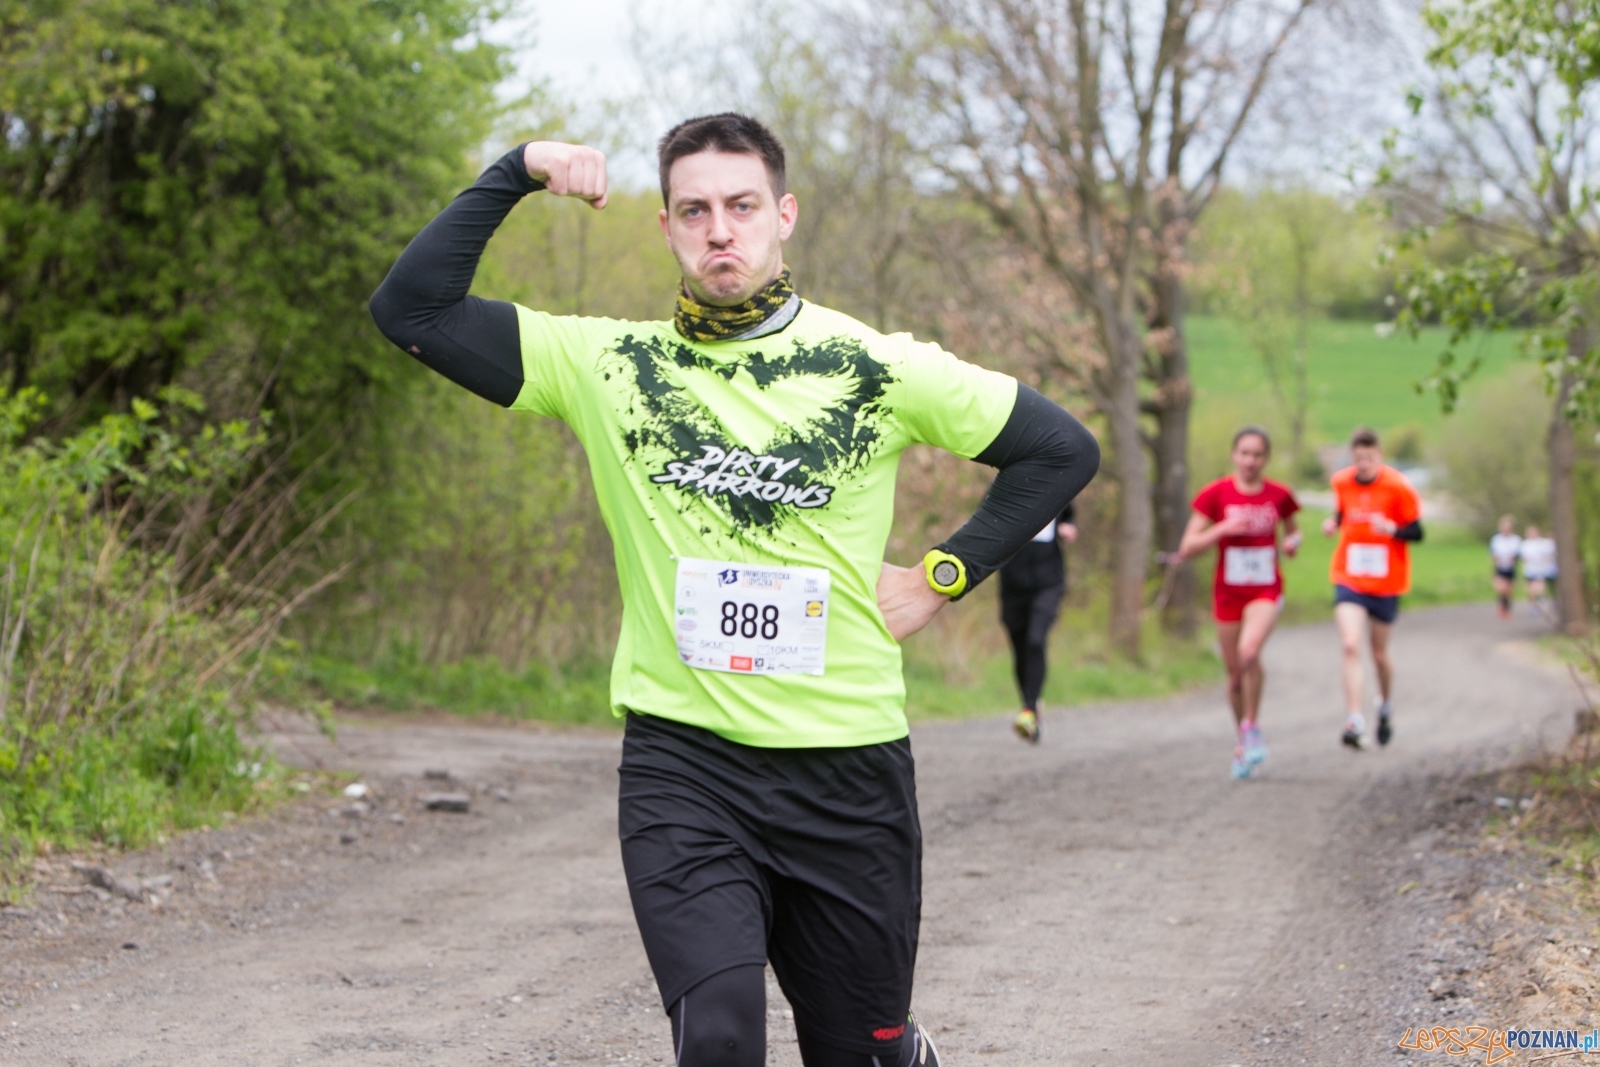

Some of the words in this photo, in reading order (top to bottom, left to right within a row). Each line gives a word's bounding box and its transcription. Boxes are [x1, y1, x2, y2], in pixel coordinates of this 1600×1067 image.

[691, 444, 802, 481] DIRTY
[651, 461, 834, 508] SPARROWS
[720, 600, 780, 640] 888
[699, 640, 722, 650] 5KM
[769, 645, 799, 655] 10KM
